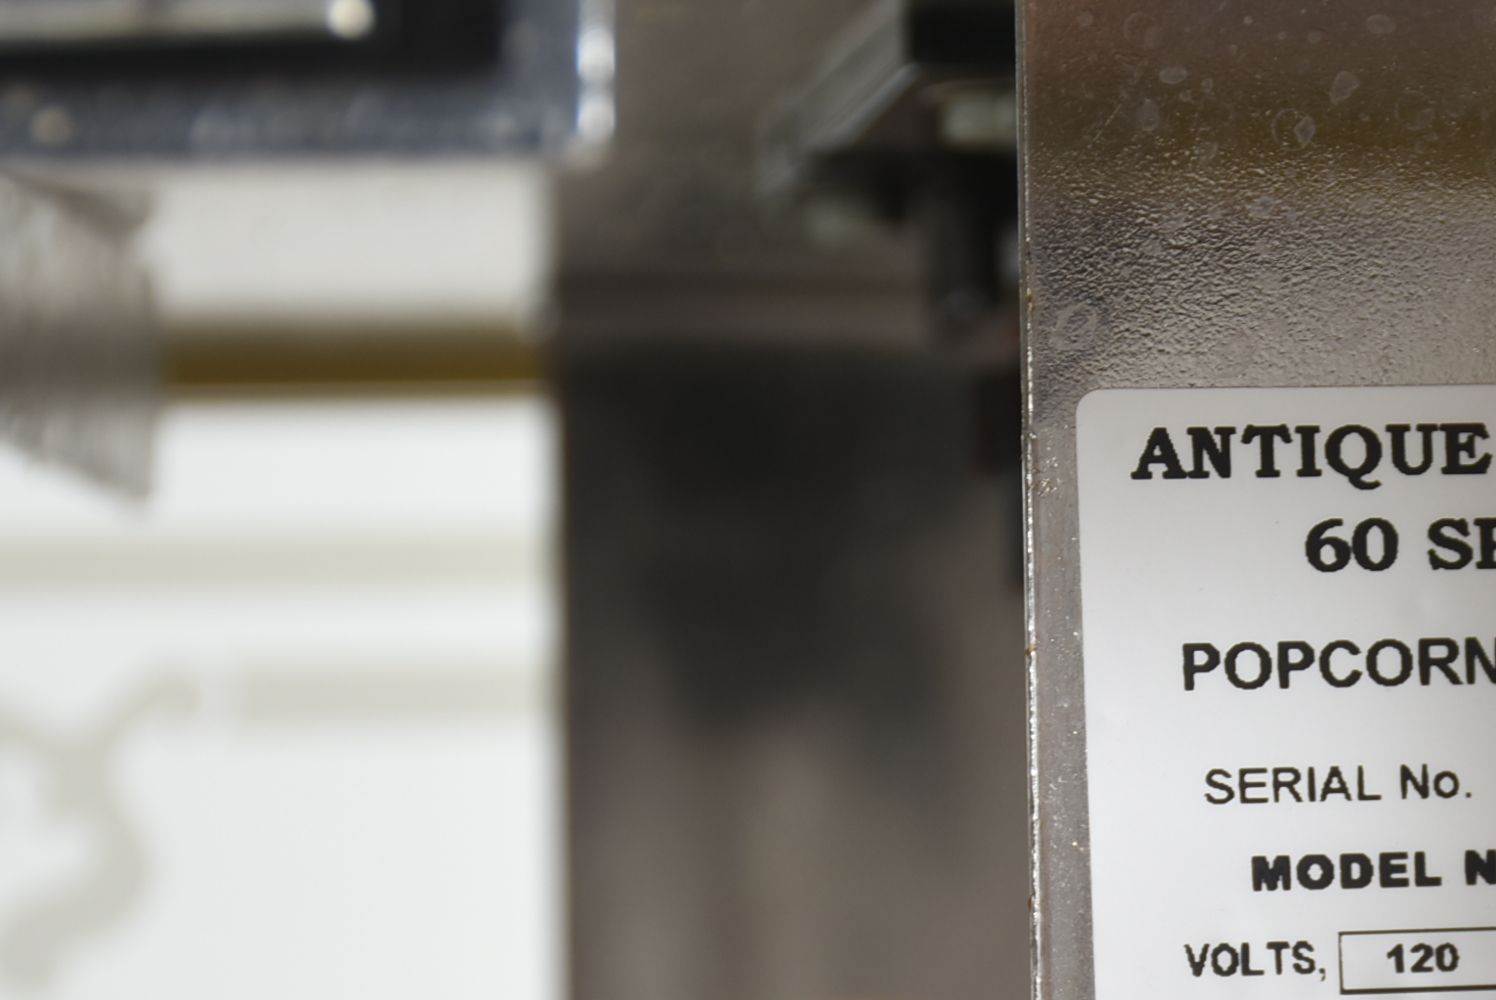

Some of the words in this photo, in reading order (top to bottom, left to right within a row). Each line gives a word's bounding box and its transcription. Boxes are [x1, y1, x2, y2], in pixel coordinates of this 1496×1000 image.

[1130, 422, 1493, 491] ANTIQUE
[1304, 517, 1400, 574] 60
[1203, 763, 1383, 806] SERIAL
[1400, 763, 1473, 801] No.
[1250, 850, 1443, 893] MODEL
[1184, 939, 1328, 982] VOLTS,
[1385, 941, 1461, 975] 120
